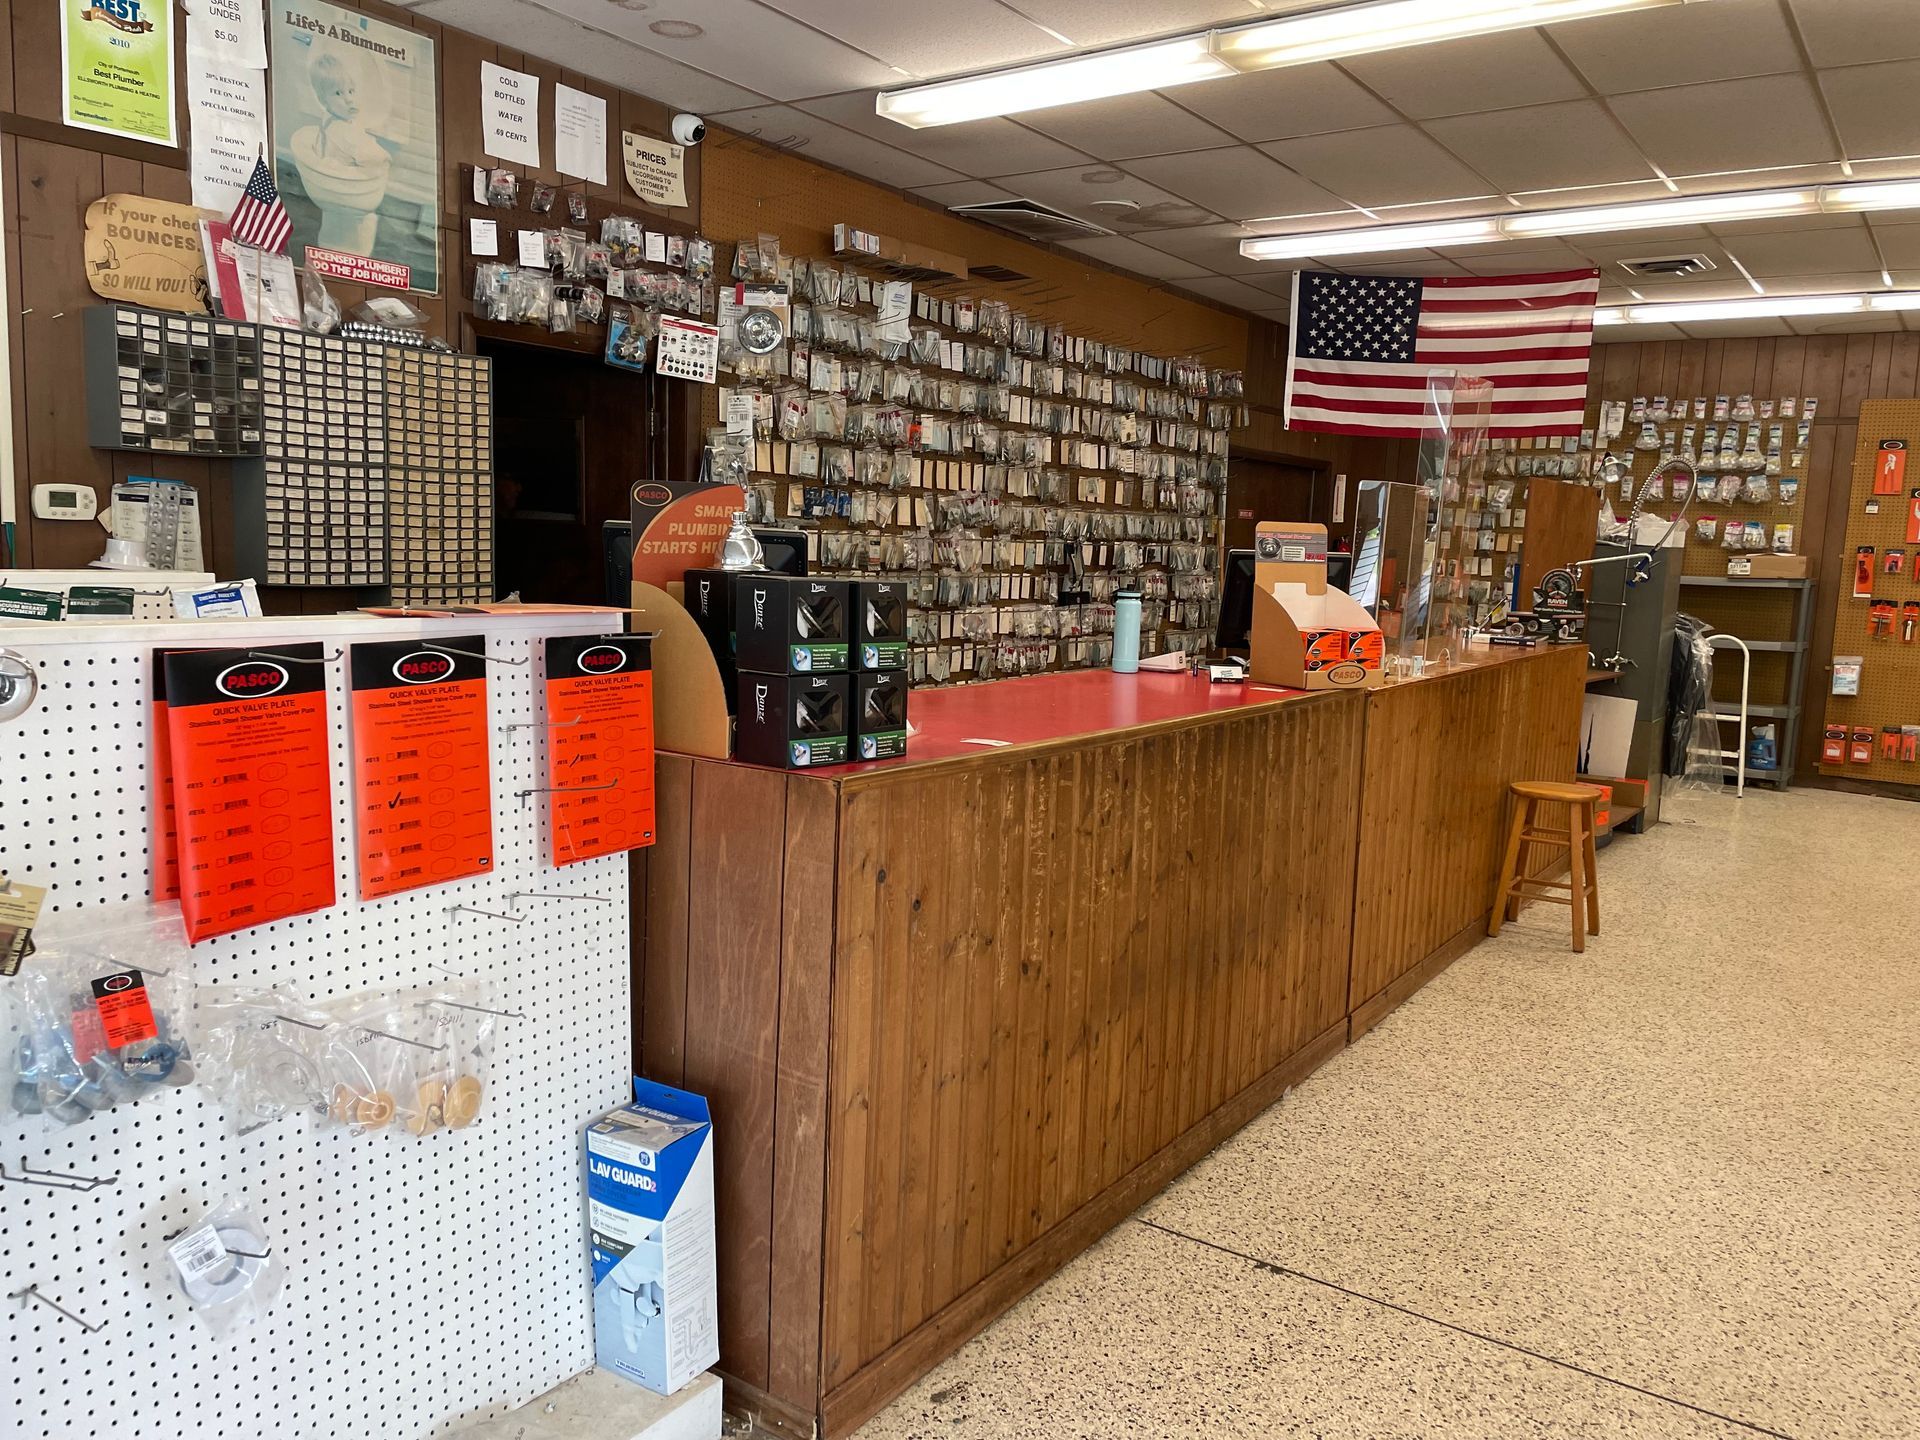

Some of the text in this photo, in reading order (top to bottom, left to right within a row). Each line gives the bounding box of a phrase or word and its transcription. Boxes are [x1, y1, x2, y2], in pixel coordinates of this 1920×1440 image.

[209, 7, 241, 22] UNDER
[109, 37, 130, 48] 2010
[215, 29, 238, 43] $5.00
[286, 10, 406, 61] Life's A Bummer!
[94, 69, 144, 86] Best Plumber
[205, 72, 249, 88] 20% RESTOCK
[500, 76, 518, 88] COLD
[77, 75, 108, 87] ELLSWORTH
[109, 84, 134, 94] PLUMBING
[139, 90, 161, 100] HEATING
[494, 90, 526, 106] BOTTLED
[201, 100, 255, 118] SPECIAL ORDERS
[498, 110, 523, 123] WATER
[225, 138, 245, 146] DOWN
[505, 131, 527, 143] CENTS
[210, 148, 237, 159] DEPOSIT
[636, 149, 667, 166] PRICES
[626, 160, 649, 171] SUBJECT
[656, 168, 677, 179] CHANGE
[633, 170, 663, 183] ACCORDING
[204, 176, 232, 186] SPECIAL
[636, 178, 669, 192] CUSTOMER'S
[640, 187, 665, 198] ATTITUDE
[103, 201, 117, 216] If
[120, 209, 157, 223] your
[309, 249, 407, 277] LICENSED PLUMBERS
[313, 260, 404, 286] DO THE JOB RIGHT!
[102, 273, 187, 293] SO WILL YOU!
[639, 490, 668, 499] PASCO
[642, 541, 698, 554] STARTS
[21, 604, 48, 612] BREAKER
[754, 588, 766, 630] Danze
[584, 653, 620, 666] PASCO
[402, 660, 448, 675] PASCO
[1333, 671, 1361, 679] PASCO
[226, 671, 280, 689] PASCO
[594, 677, 612, 685] VALVE
[389, 685, 460, 699] QUICK VALVE PLATE
[213, 699, 296, 716] QUICK VALVE PLATE
[756, 683, 767, 724] Danze
[189, 720, 221, 729] Stainless
[222, 717, 239, 725] Steel
[240, 713, 264, 723] Shower
[266, 711, 281, 720] Valve
[283, 709, 300, 717] Cover
[631, 1104, 680, 1121] LAV GUARD
[590, 1158, 611, 1178] LAV
